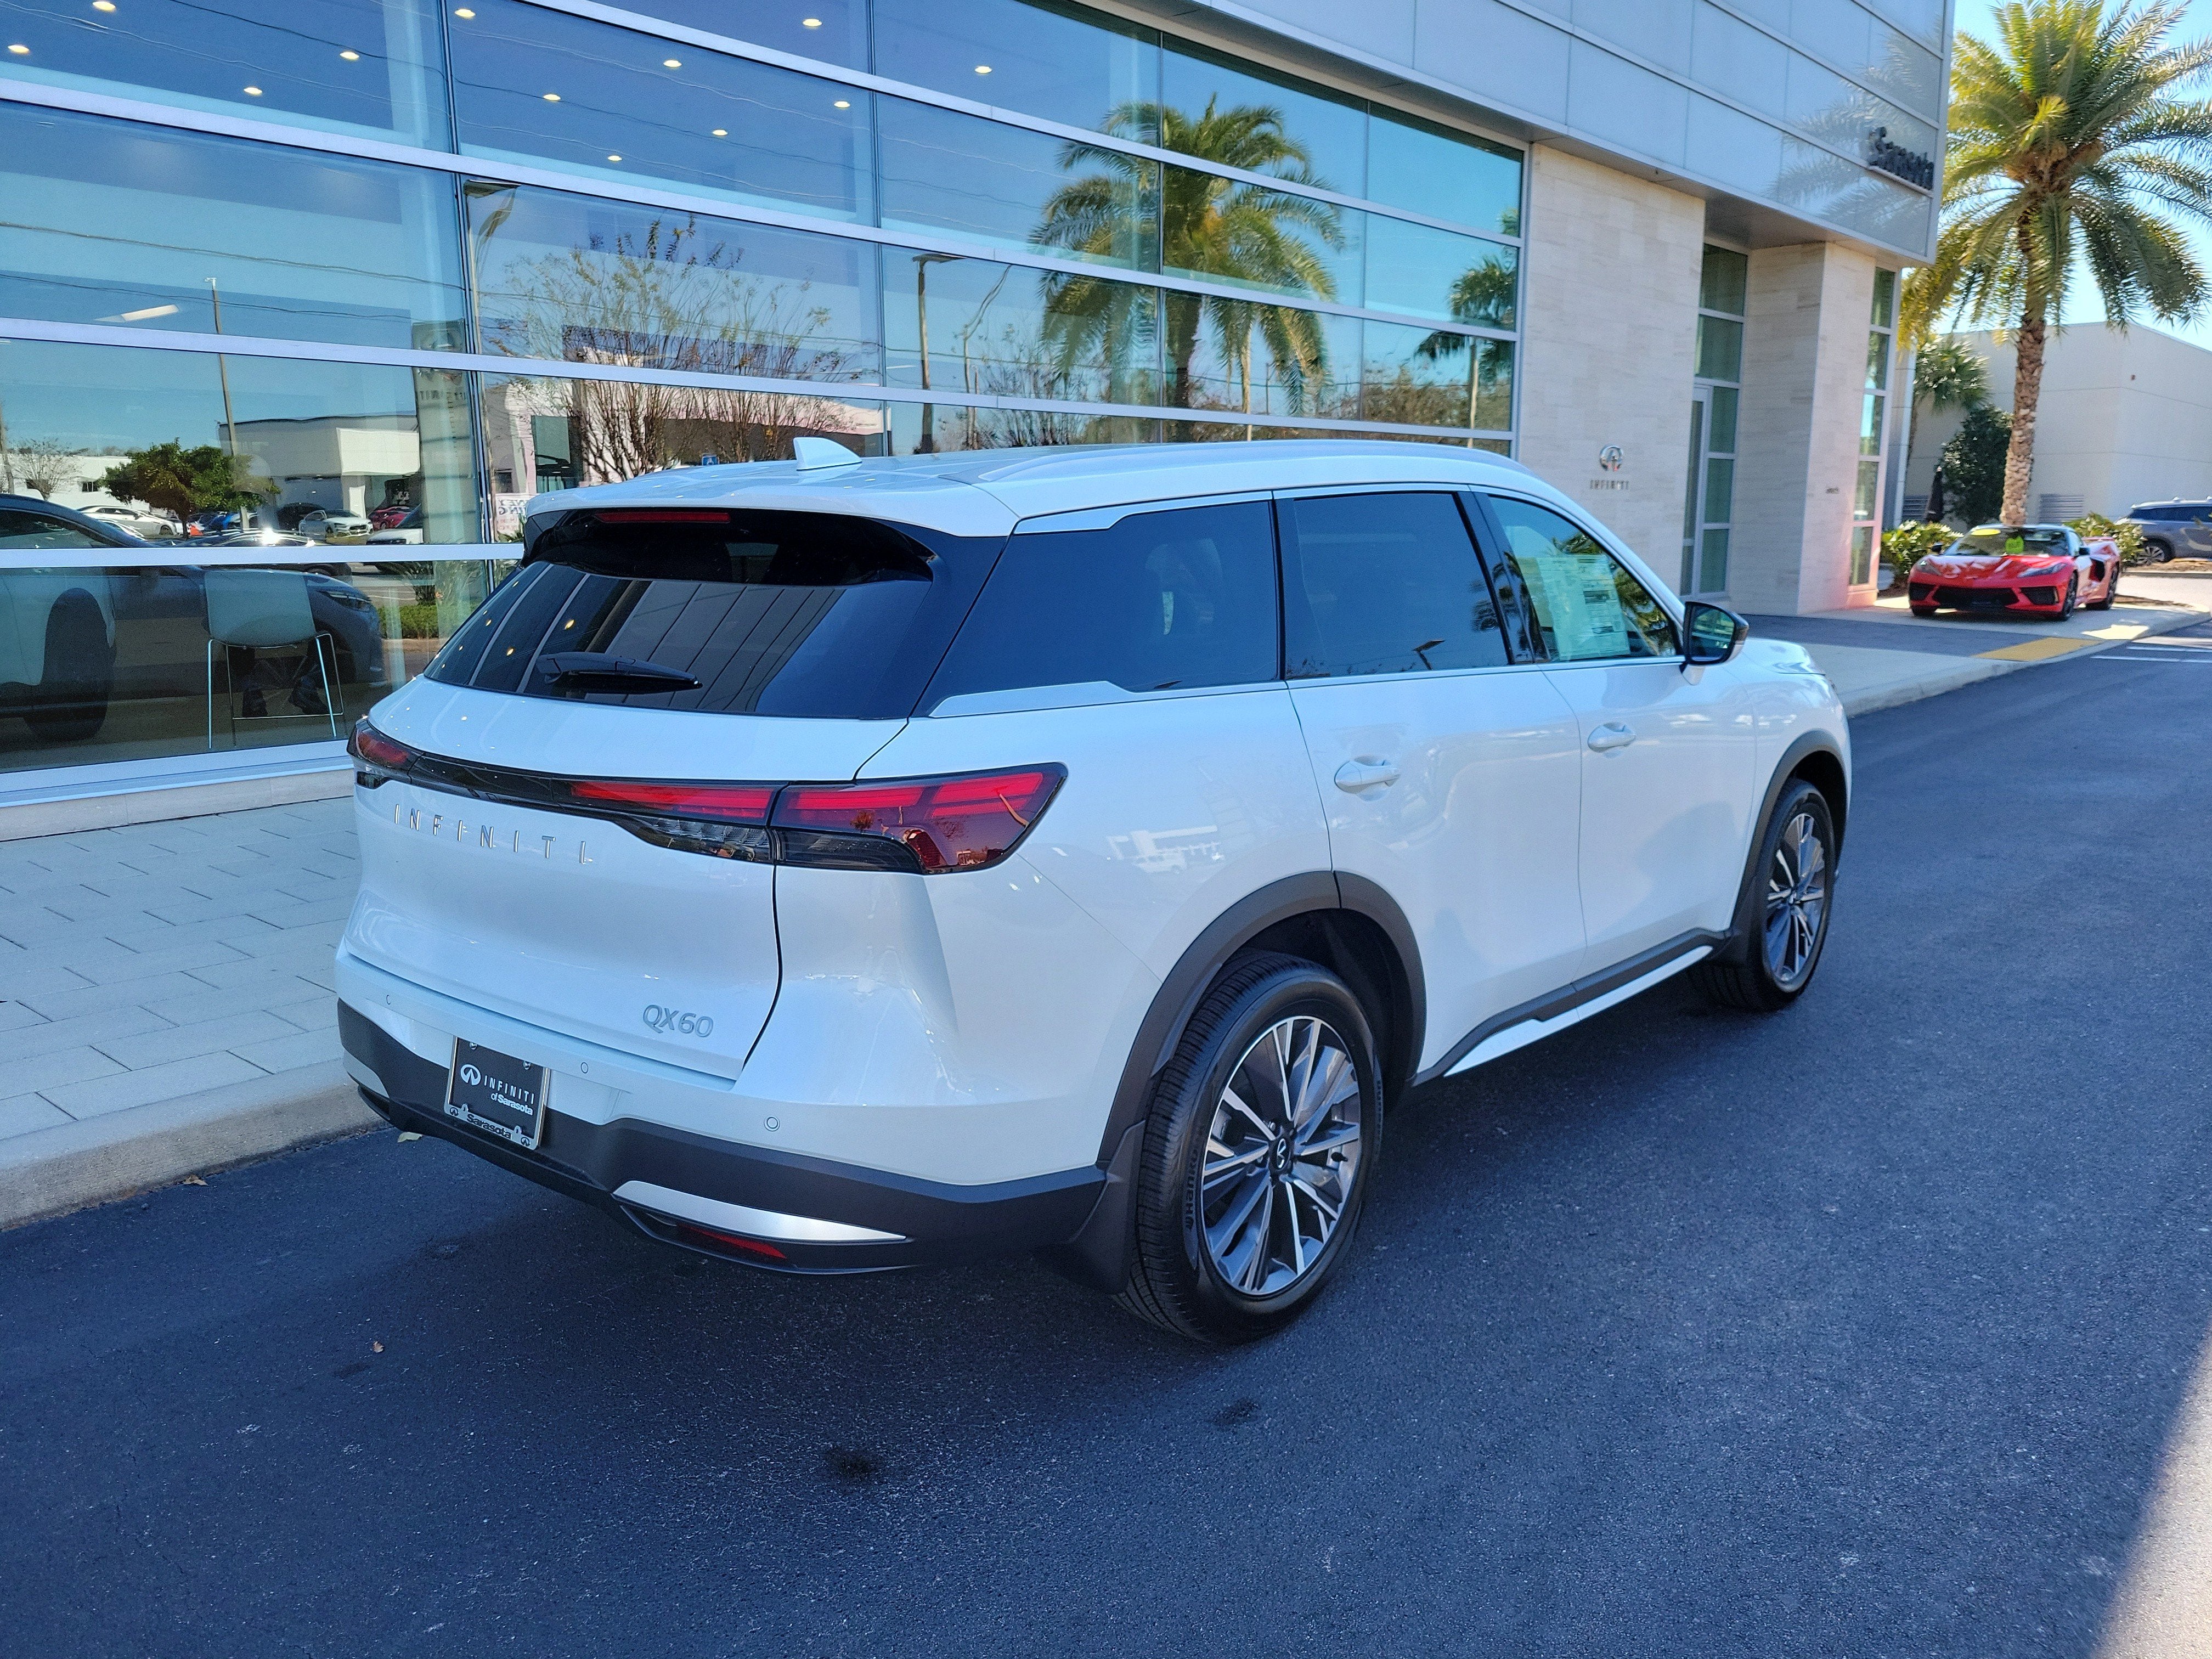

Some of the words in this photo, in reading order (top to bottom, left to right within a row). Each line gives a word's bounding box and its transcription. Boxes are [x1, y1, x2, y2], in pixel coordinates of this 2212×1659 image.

[394, 804, 587, 864] INFINITI
[643, 1005, 714, 1037] QX60
[484, 1075, 534, 1104] INFINITI
[490, 1092, 498, 1101] of
[498, 1094, 533, 1116] Sarasota
[467, 1114, 512, 1139] Sarasota
